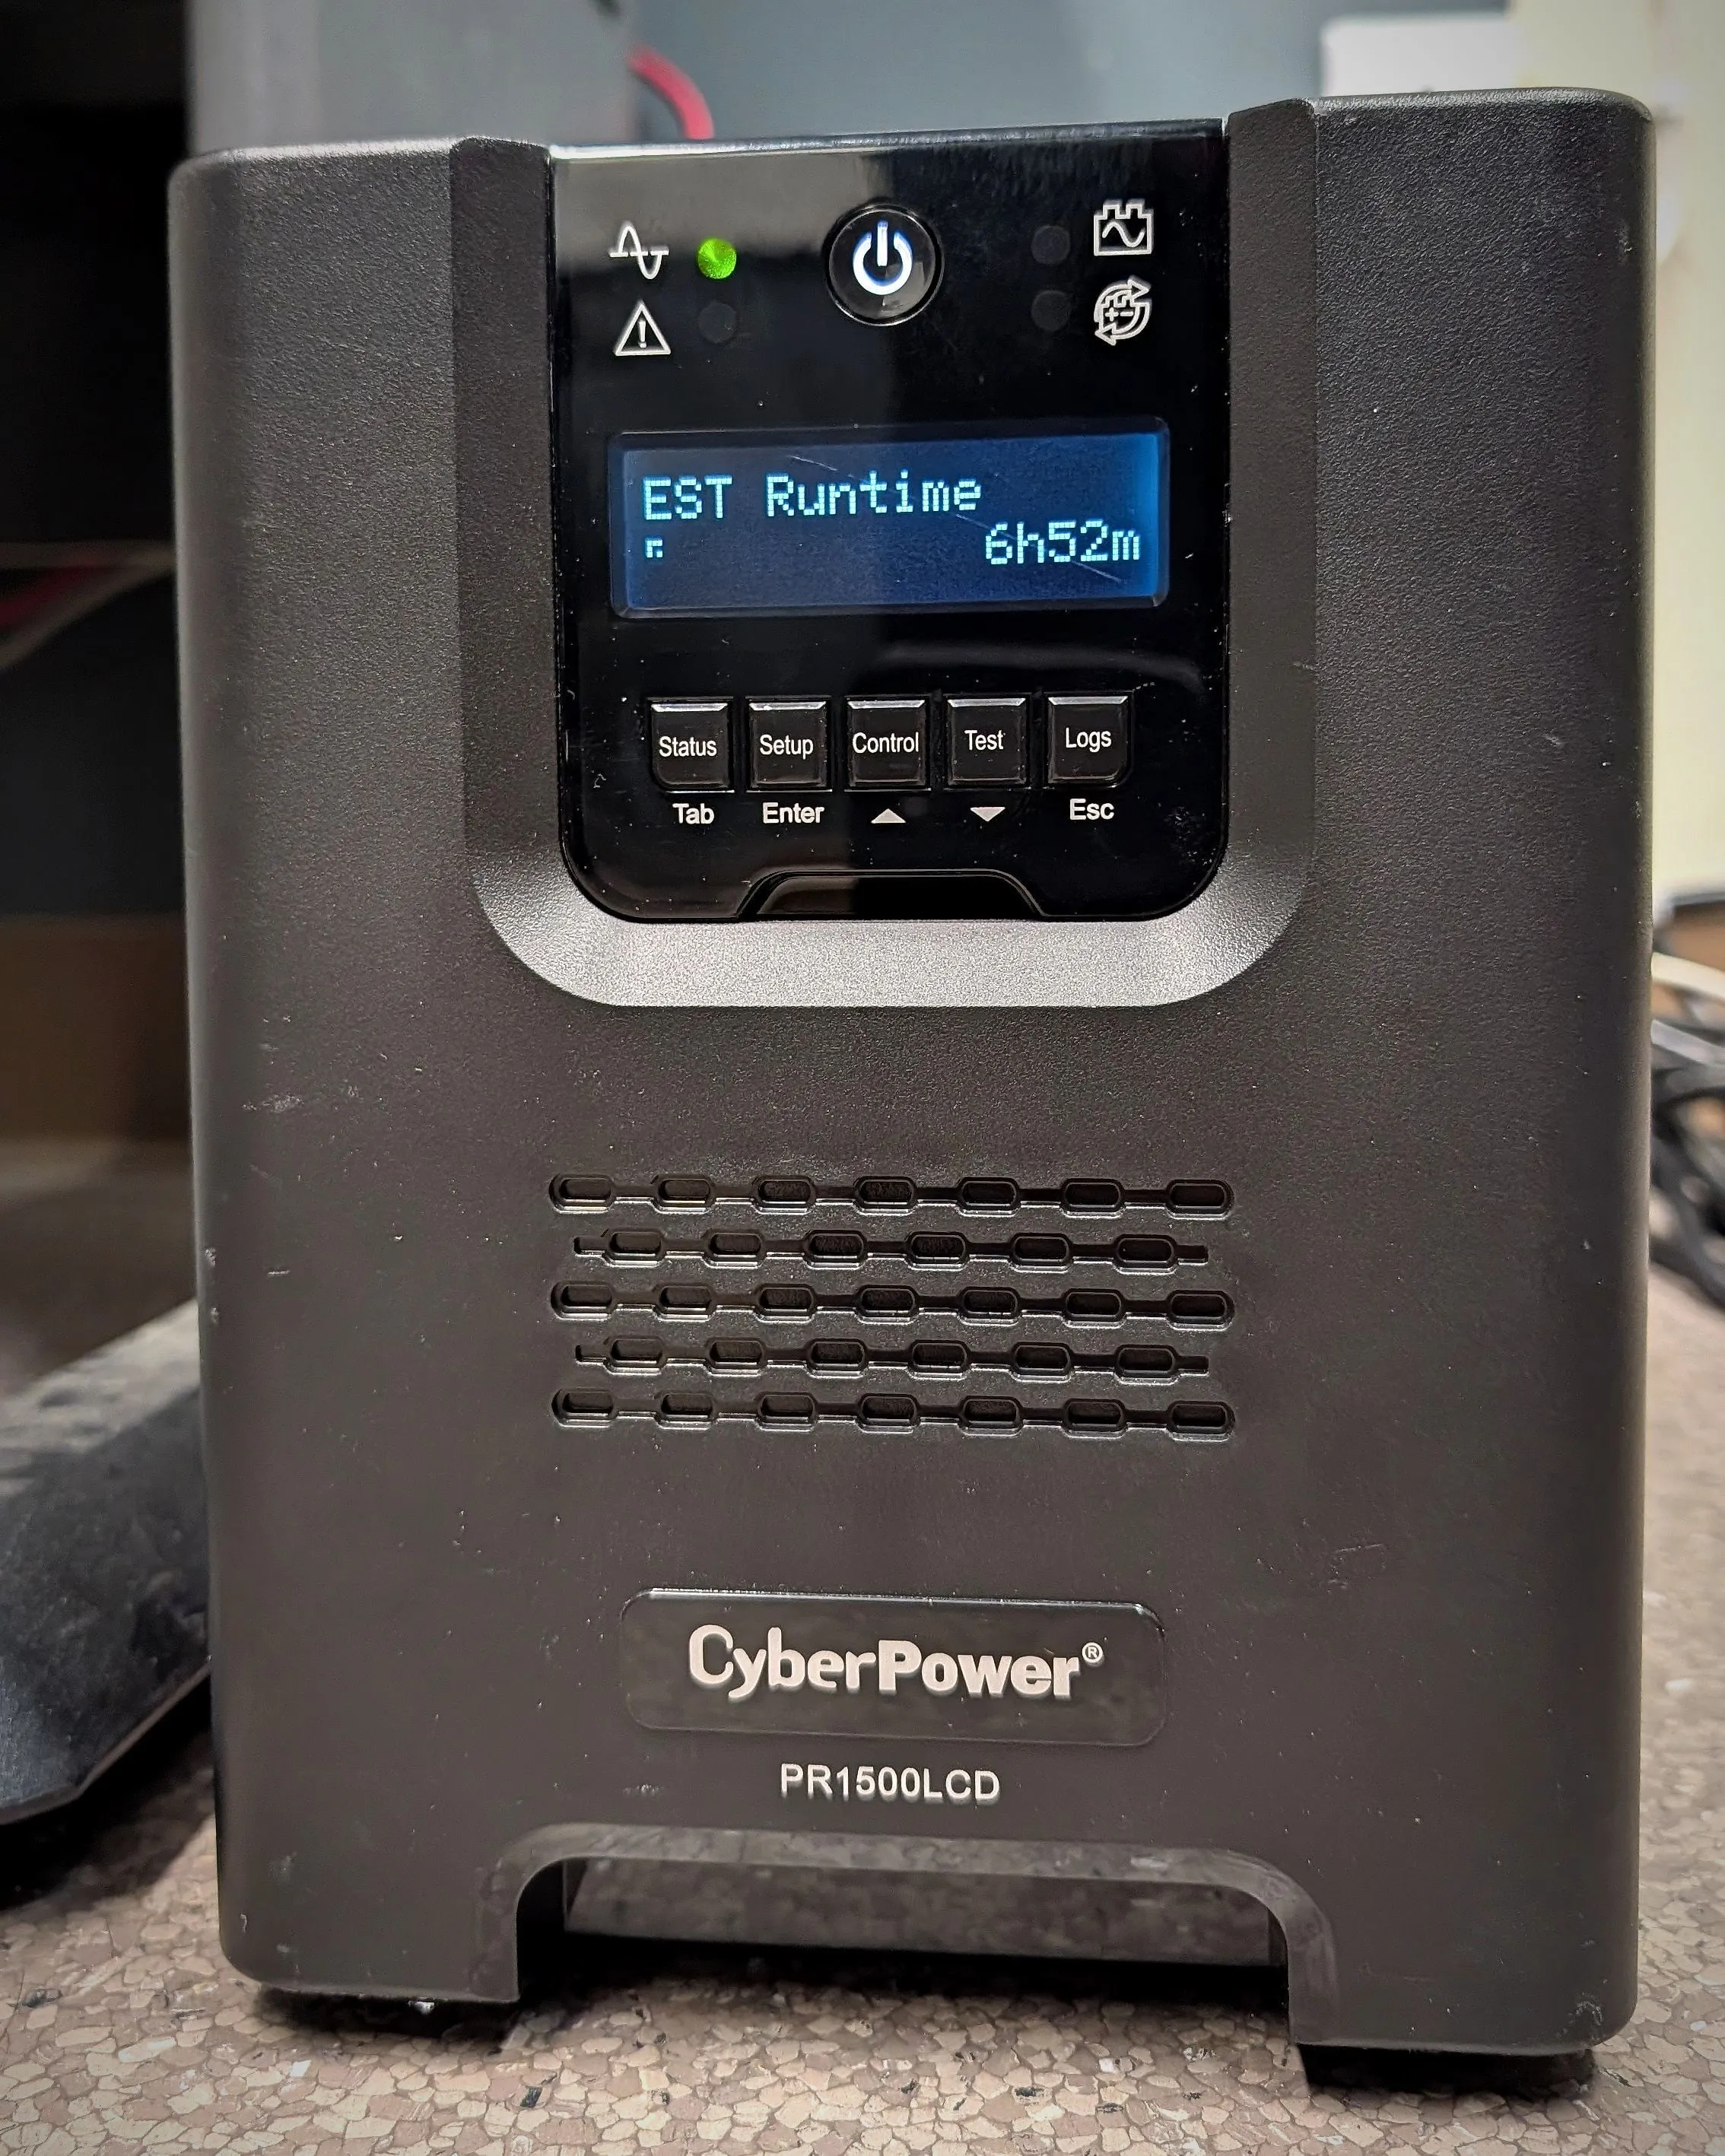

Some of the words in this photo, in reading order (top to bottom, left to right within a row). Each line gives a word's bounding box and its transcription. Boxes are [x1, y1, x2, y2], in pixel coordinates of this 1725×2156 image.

[643, 475, 732, 521] EST
[766, 469, 981, 516] Runtime
[985, 519, 1141, 564] 6h52m
[659, 735, 717, 757] Status
[760, 734, 814, 760] Setup
[853, 732, 919, 754] Control
[964, 729, 1004, 751] Test
[1065, 727, 1111, 751] Logs
[672, 803, 714, 825] Tab
[763, 802, 824, 824] Enter
[1069, 799, 1114, 821] Esc
[781, 1763, 1000, 1802] PR1500LCD
